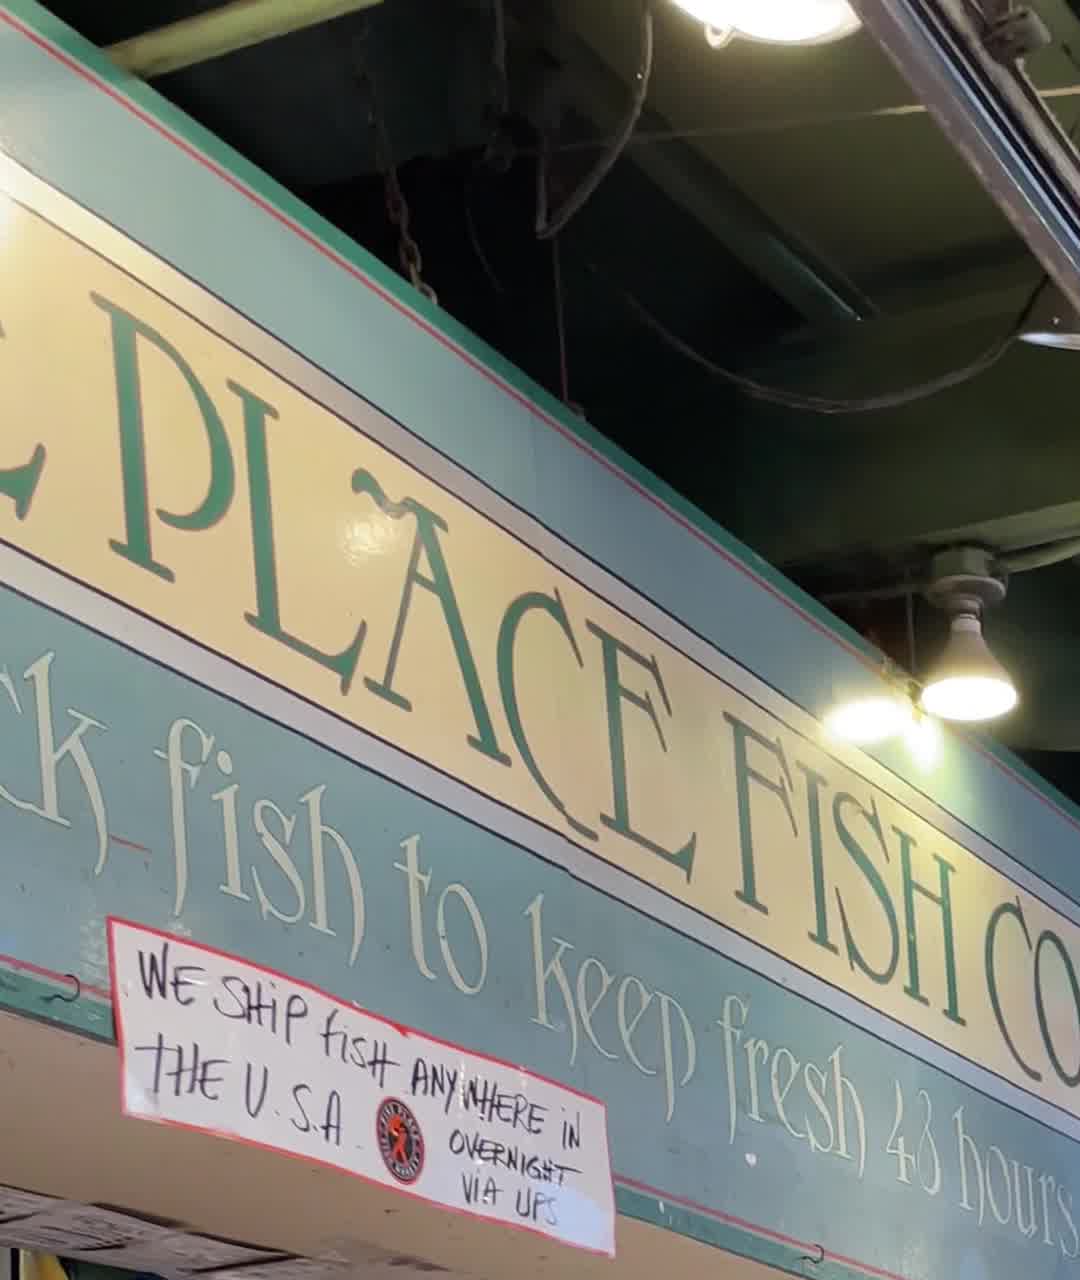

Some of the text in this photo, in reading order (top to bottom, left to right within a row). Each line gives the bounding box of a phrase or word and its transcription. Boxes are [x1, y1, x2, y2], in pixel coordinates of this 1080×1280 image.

[90, 290, 697, 883] PLACE
[724, 711, 966, 1025] FISH
[138, 942, 207, 1005] WE
[411, 1057, 550, 1135] ANYWHERE
[154, 717, 365, 967] fish
[394, 833, 488, 994] to
[522, 893, 697, 1122] keep
[717, 995, 868, 1180] fresh
[952, 1104, 1080, 1260] hours
[135, 1033, 231, 1101] THE
[448, 1129, 583, 1187] OVERNIGHT
[515, 1188, 559, 1226] UPS
